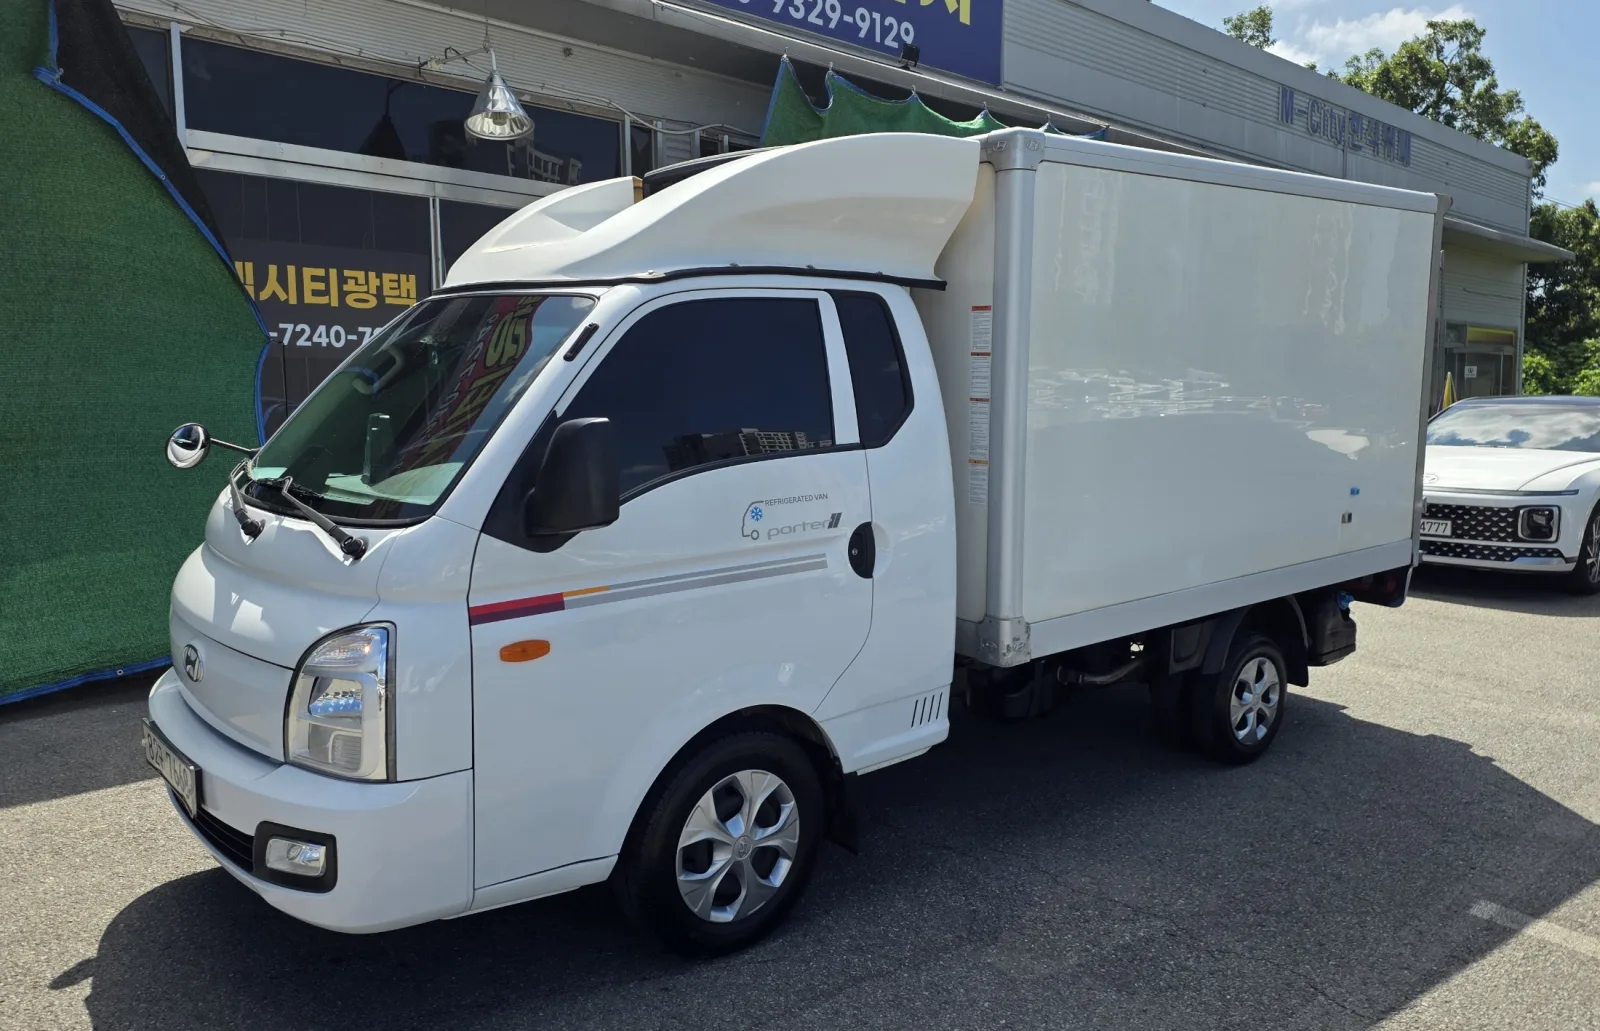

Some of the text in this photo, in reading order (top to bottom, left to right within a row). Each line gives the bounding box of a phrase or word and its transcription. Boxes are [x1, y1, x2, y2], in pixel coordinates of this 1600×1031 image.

[1279, 85, 1346, 146] M-City
[269, 323, 383, 347] -7240-7
[765, 493, 828, 506] REFRIGERATED VAN
[1420, 520, 1448, 533] 4777
